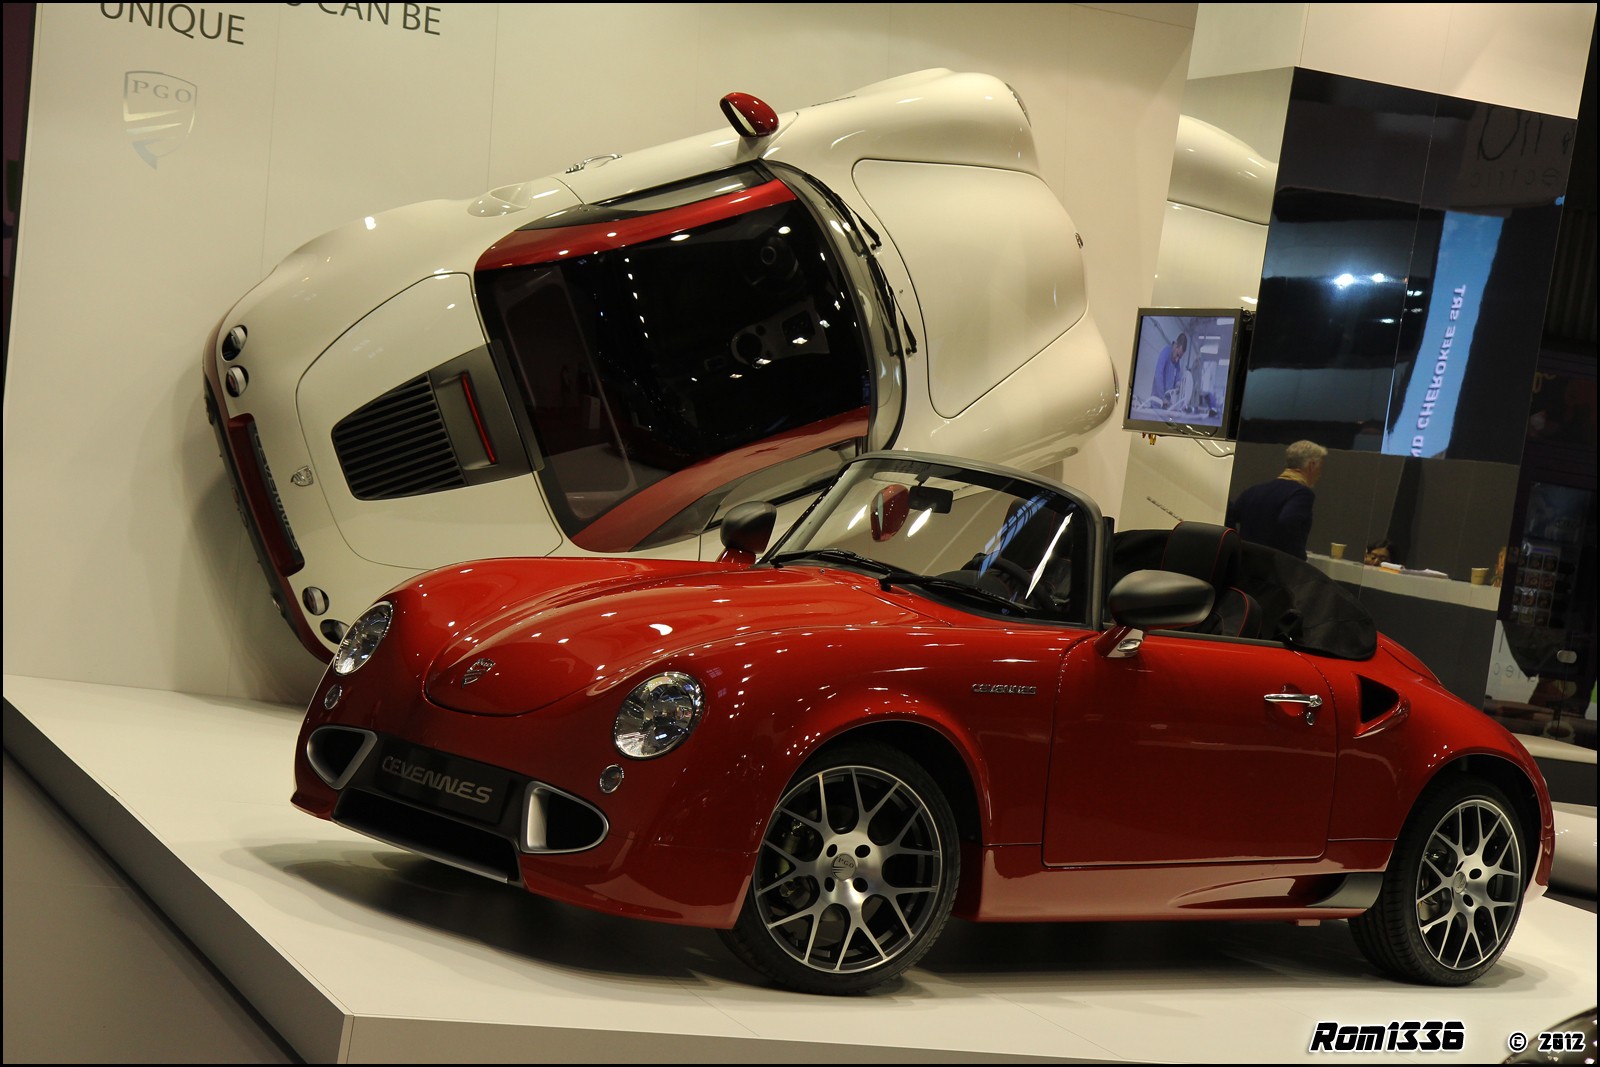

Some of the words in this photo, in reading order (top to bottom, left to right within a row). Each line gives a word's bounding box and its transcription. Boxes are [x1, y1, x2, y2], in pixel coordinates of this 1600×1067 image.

[100, 3, 245, 45] UNIQUE
[402, 3, 441, 36] BE
[131, 80, 192, 103] PGO
[382, 755, 493, 804] CEVENNES
[838, 857, 855, 868] PGO
